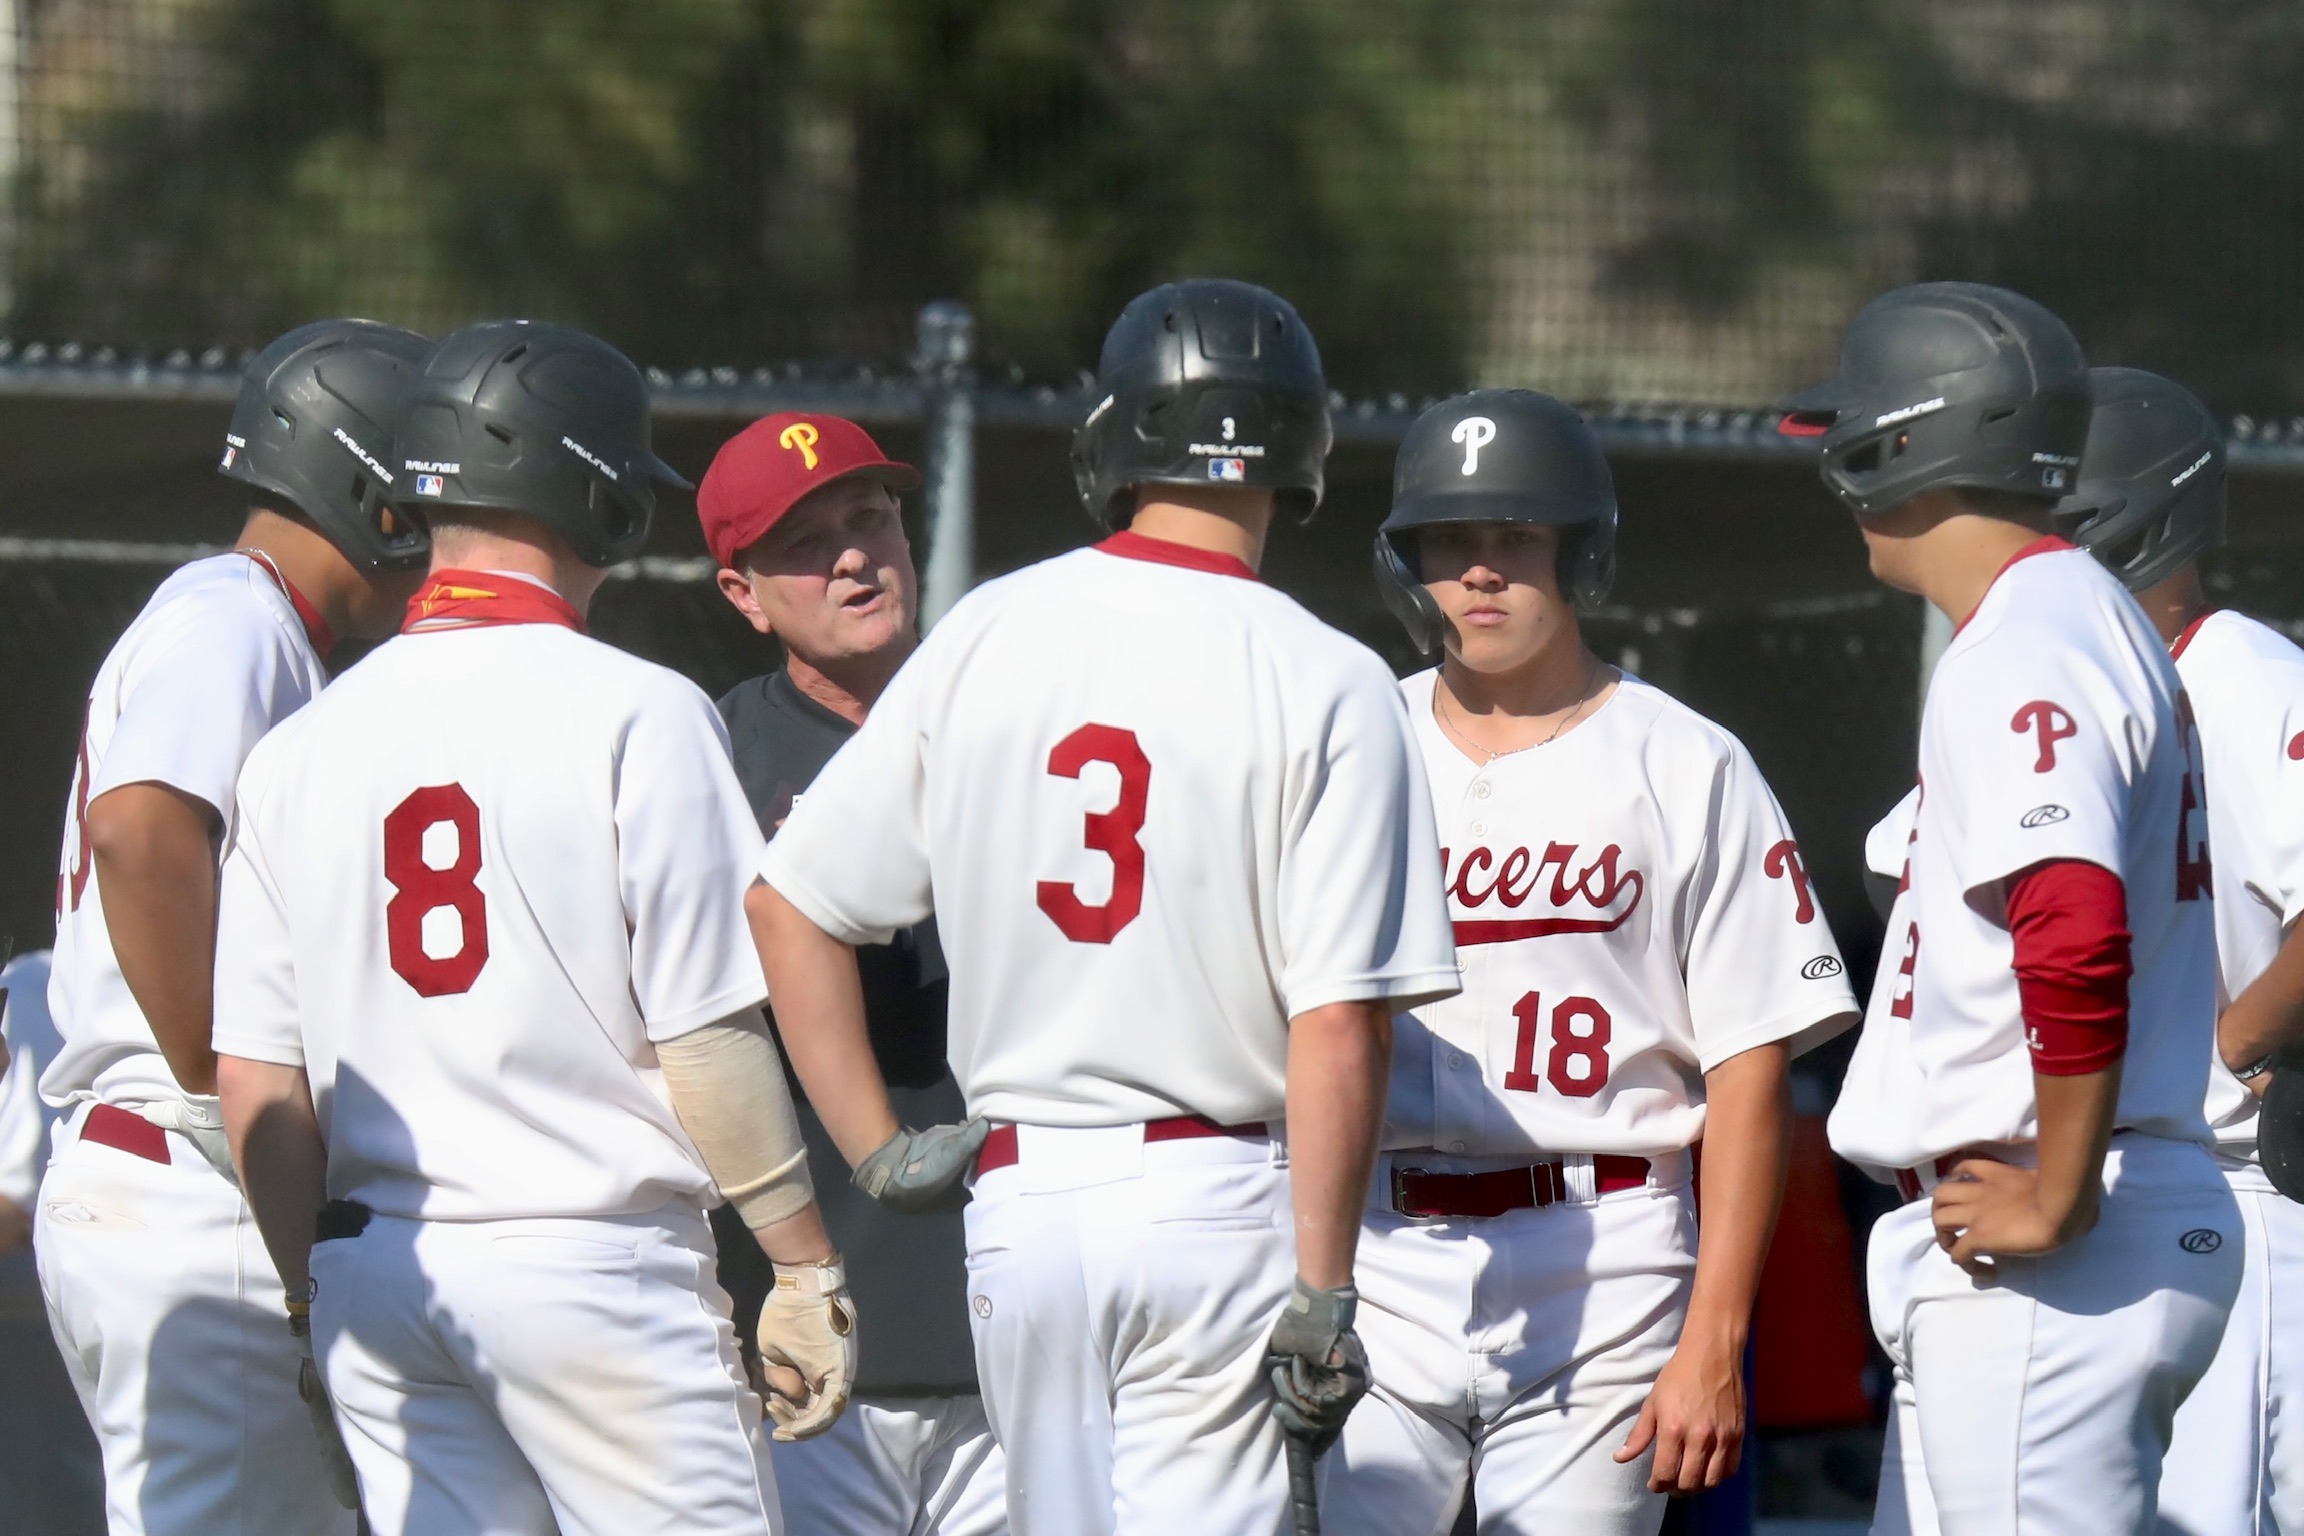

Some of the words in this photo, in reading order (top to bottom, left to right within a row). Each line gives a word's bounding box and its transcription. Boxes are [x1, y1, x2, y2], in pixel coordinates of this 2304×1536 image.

[333, 427, 394, 485] RAWLINGS
[562, 435, 618, 480] RAWLINGS
[779, 422, 819, 470] P
[1221, 416, 1236, 441] 3
[1451, 416, 1497, 476] P
[404, 459, 460, 475] RAWLINGS
[2010, 699, 2077, 773] P
[1036, 722, 1152, 944] 3
[384, 781, 489, 999] 8
[1504, 990, 1611, 1098] 18
